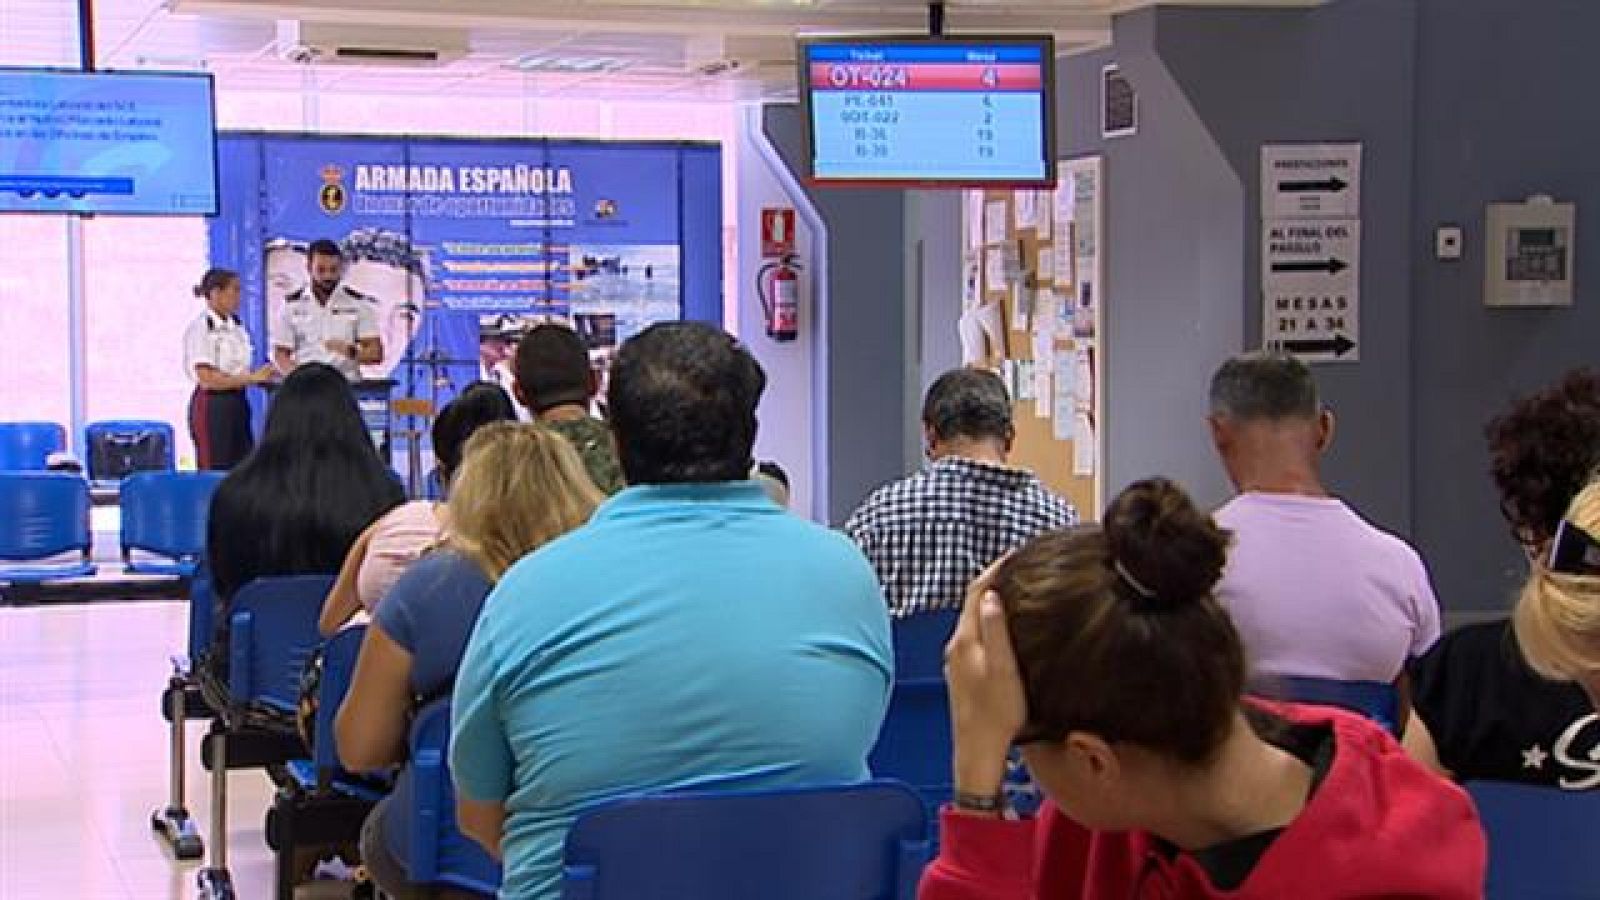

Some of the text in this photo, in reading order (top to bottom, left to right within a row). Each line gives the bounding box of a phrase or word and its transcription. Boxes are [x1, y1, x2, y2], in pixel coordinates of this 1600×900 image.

[983, 67, 996, 88] 4
[354, 164, 572, 193] ARMADA ESPAÑOLA
[1270, 225, 1349, 240] AL FINAL DEL
[1275, 296, 1348, 311] MESAS
[1279, 316, 1297, 331] 21
[1305, 316, 1318, 331] A
